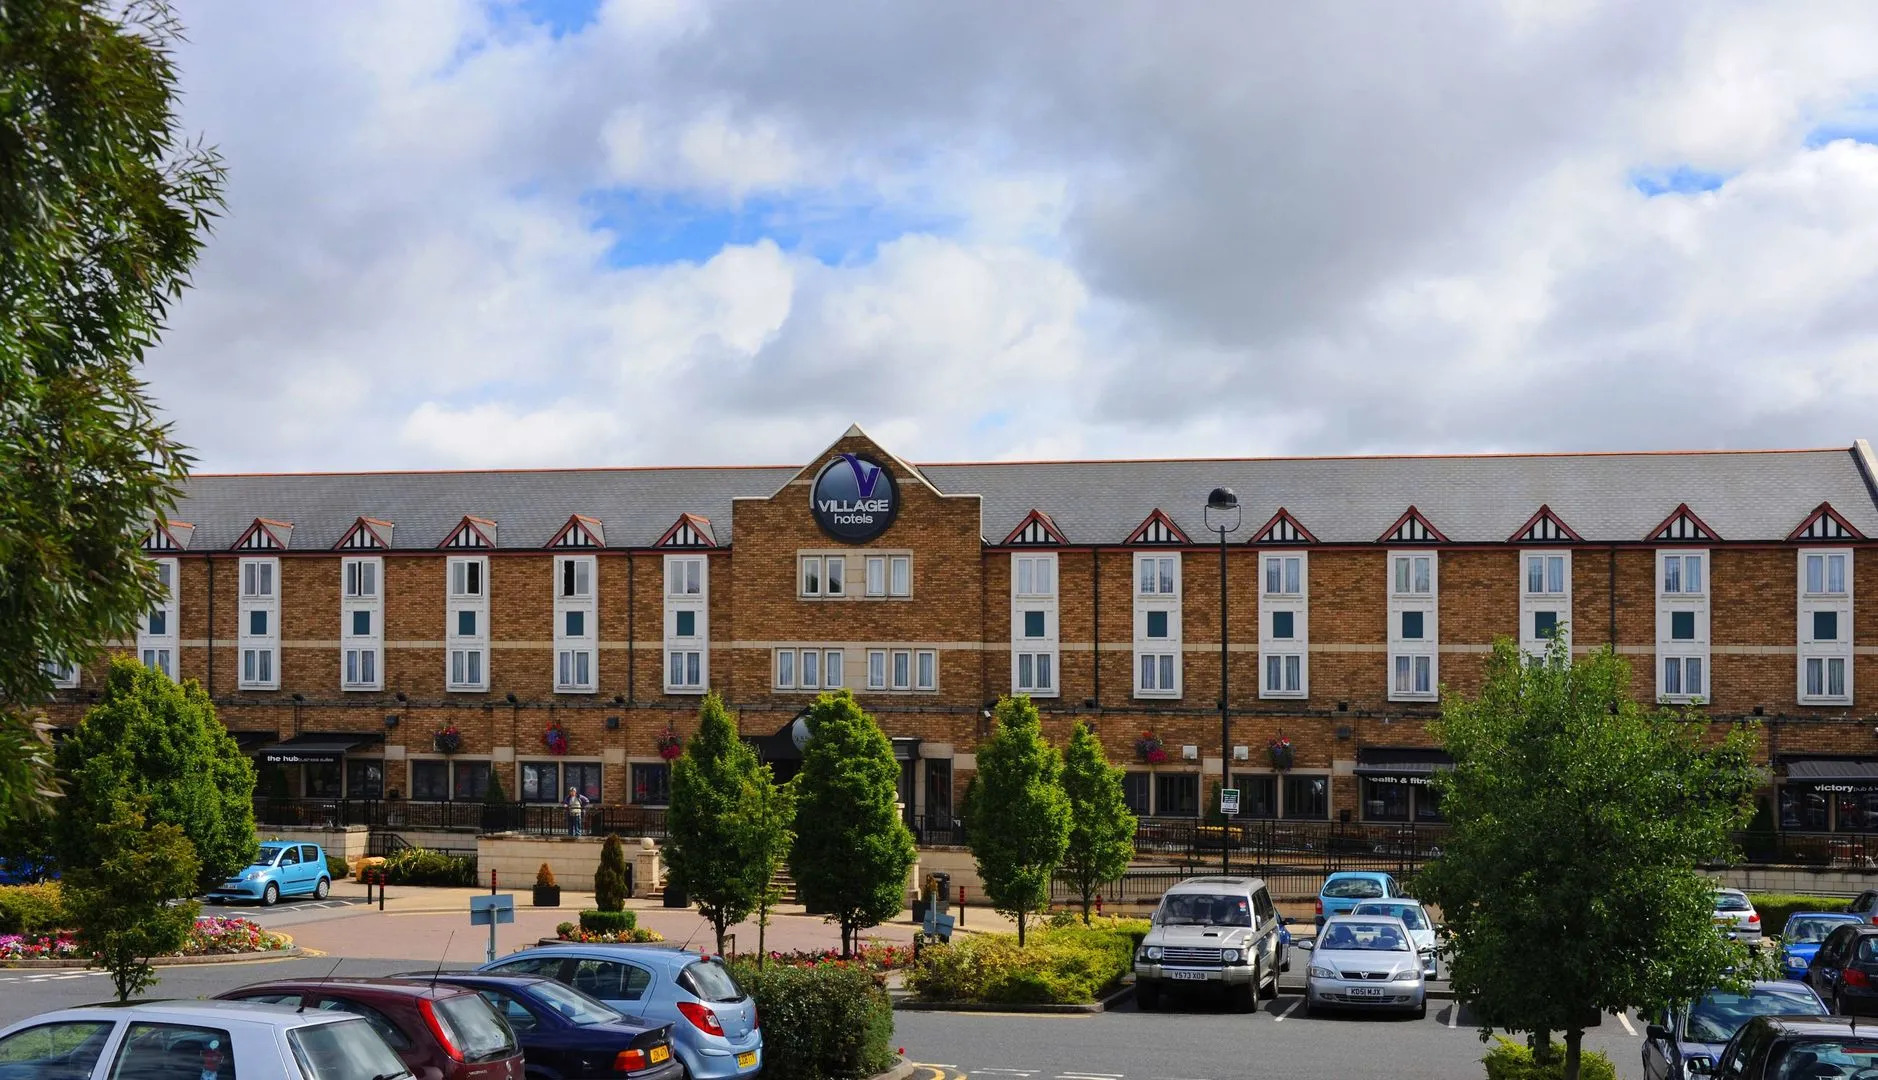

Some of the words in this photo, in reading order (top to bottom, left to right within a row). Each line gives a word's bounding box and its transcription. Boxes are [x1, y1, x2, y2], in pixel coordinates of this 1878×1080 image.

[817, 499, 889, 512] VILLAGE
[834, 513, 874, 524] hotels
[1814, 784, 1854, 793] victory
